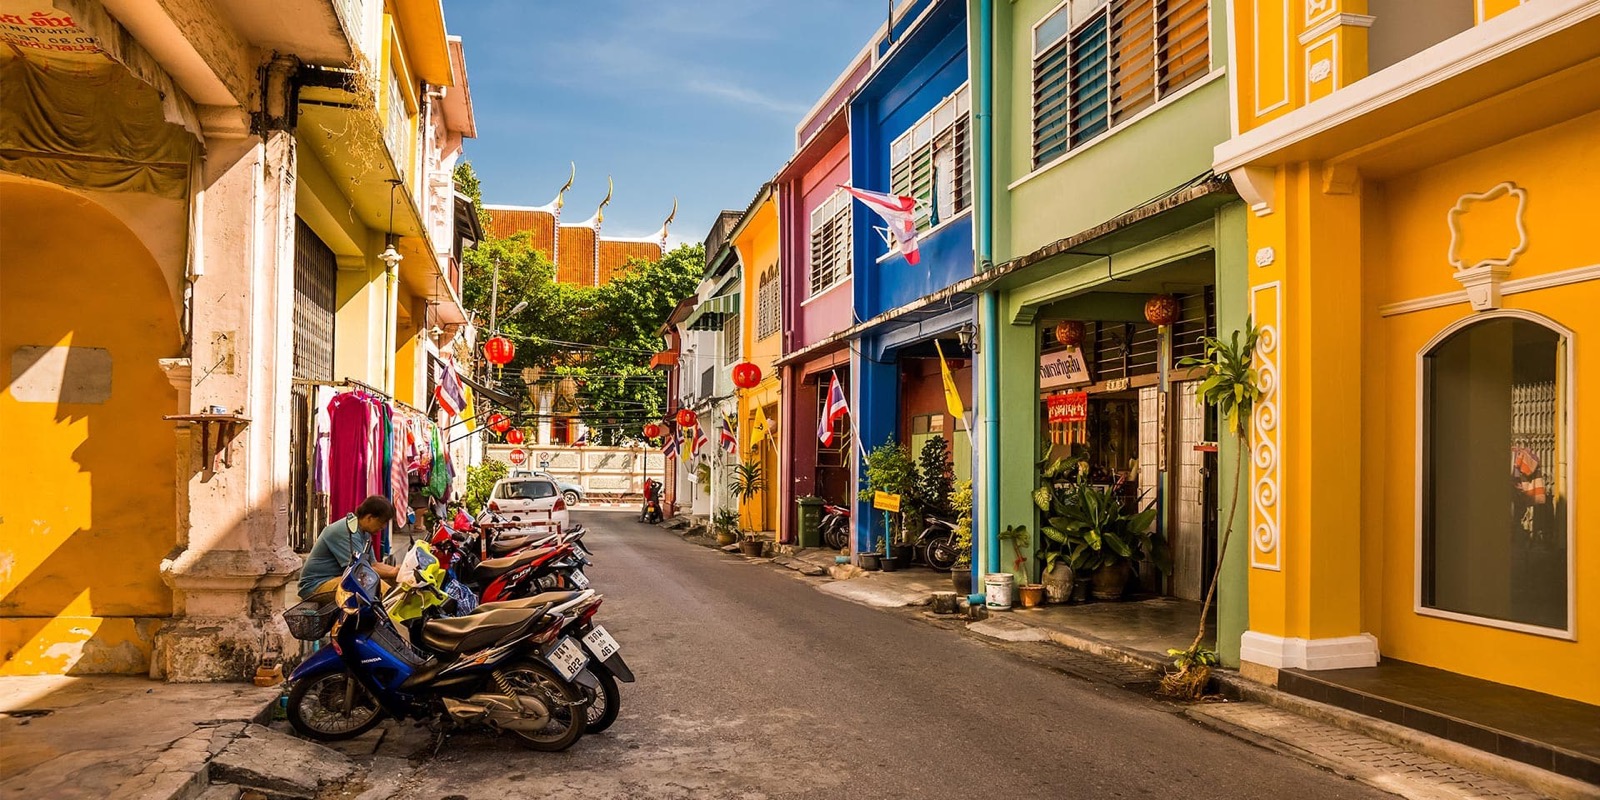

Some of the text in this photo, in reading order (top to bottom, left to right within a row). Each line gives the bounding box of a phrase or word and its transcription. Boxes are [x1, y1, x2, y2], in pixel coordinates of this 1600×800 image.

[601, 643, 615, 657] 461
[361, 656, 382, 664] HONDA
[567, 657, 583, 674] 822
